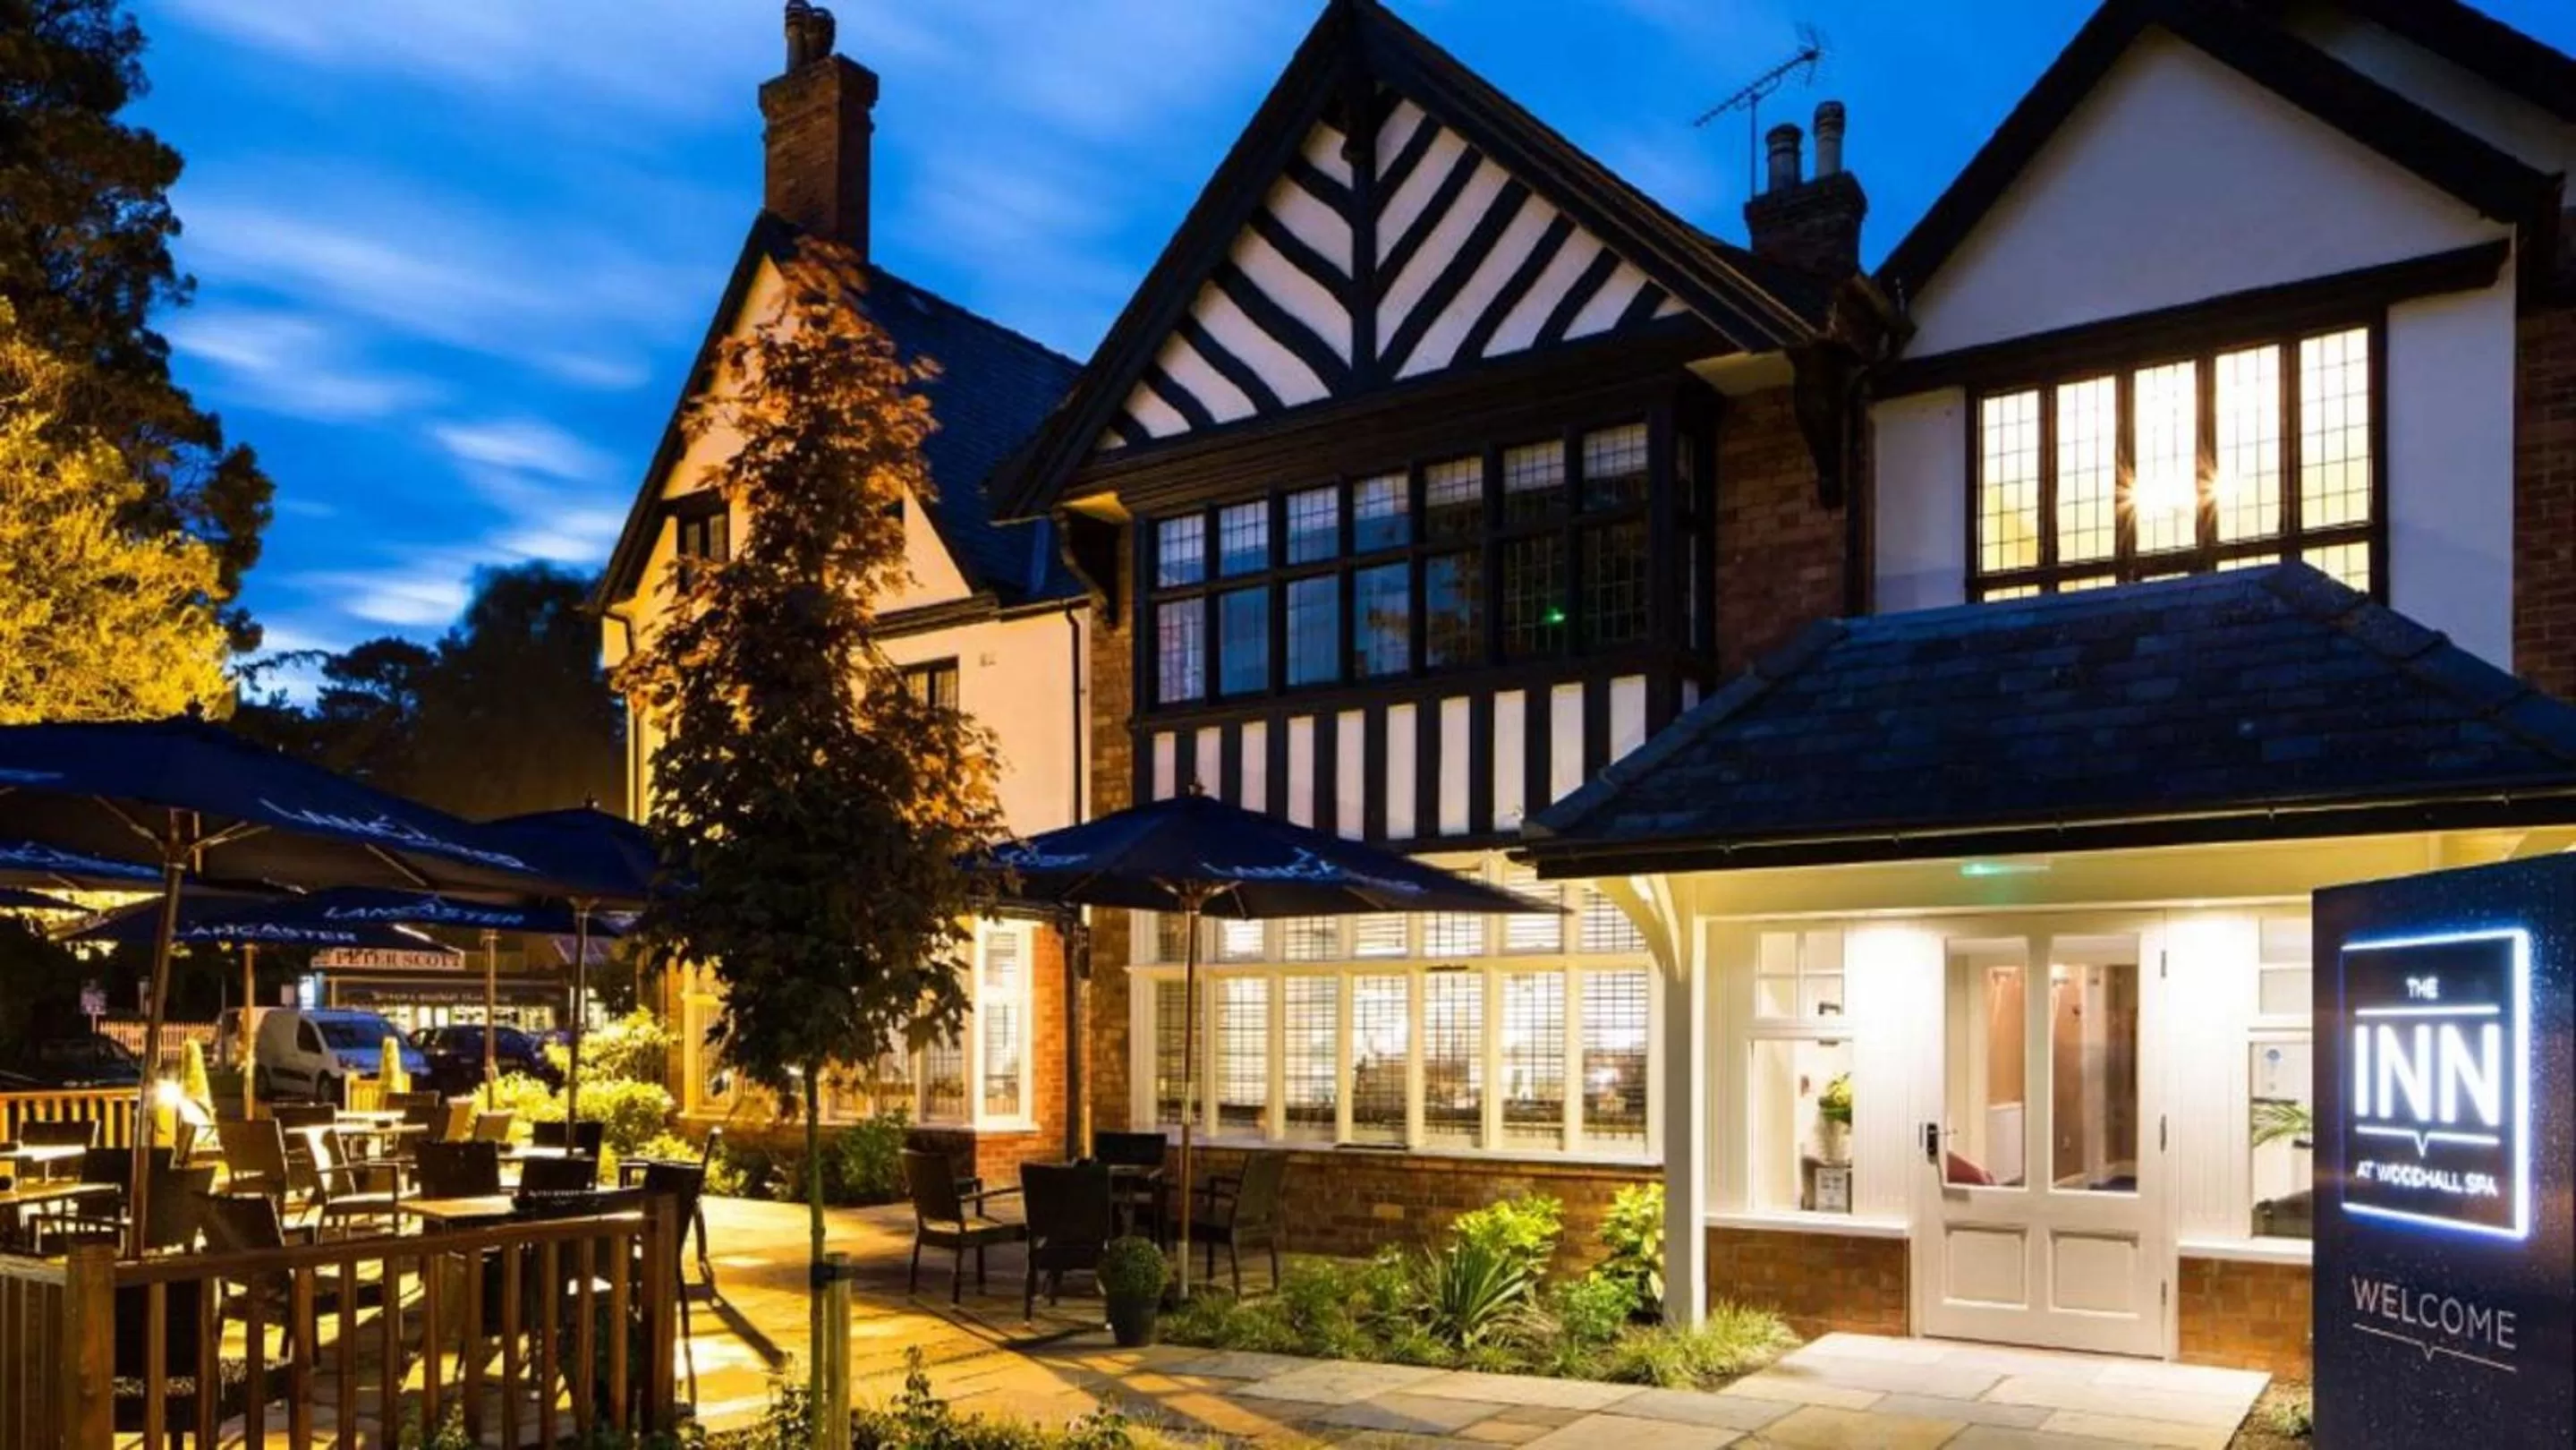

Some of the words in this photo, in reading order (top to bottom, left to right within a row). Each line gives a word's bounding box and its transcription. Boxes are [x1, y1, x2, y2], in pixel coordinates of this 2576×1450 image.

[336, 951, 398, 966] PETER
[2406, 977, 2438, 999] THE
[2355, 1024, 2501, 1126] INN
[2356, 1161, 2375, 1179] AT
[2376, 1164, 2462, 1192] WOODHALL
[2464, 1173, 2498, 1197] SPA
[2351, 1274, 2517, 1350] WELCOME
